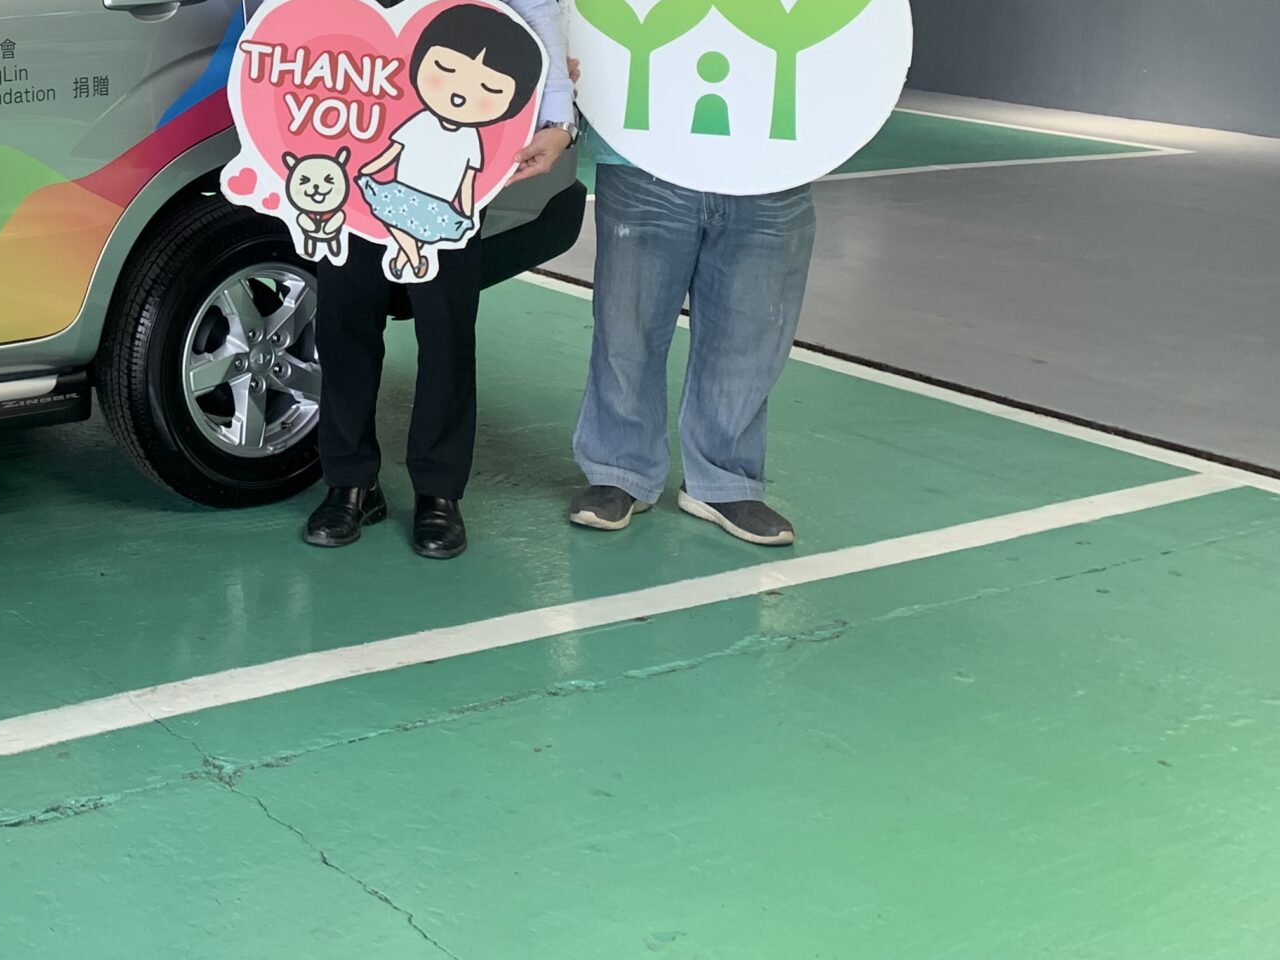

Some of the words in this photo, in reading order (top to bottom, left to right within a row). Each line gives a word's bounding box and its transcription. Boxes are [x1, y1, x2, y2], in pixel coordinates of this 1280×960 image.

[72, 75, 110, 100] 捐贈
[240, 40, 405, 100] THANK
[282, 91, 387, 143] YOU
